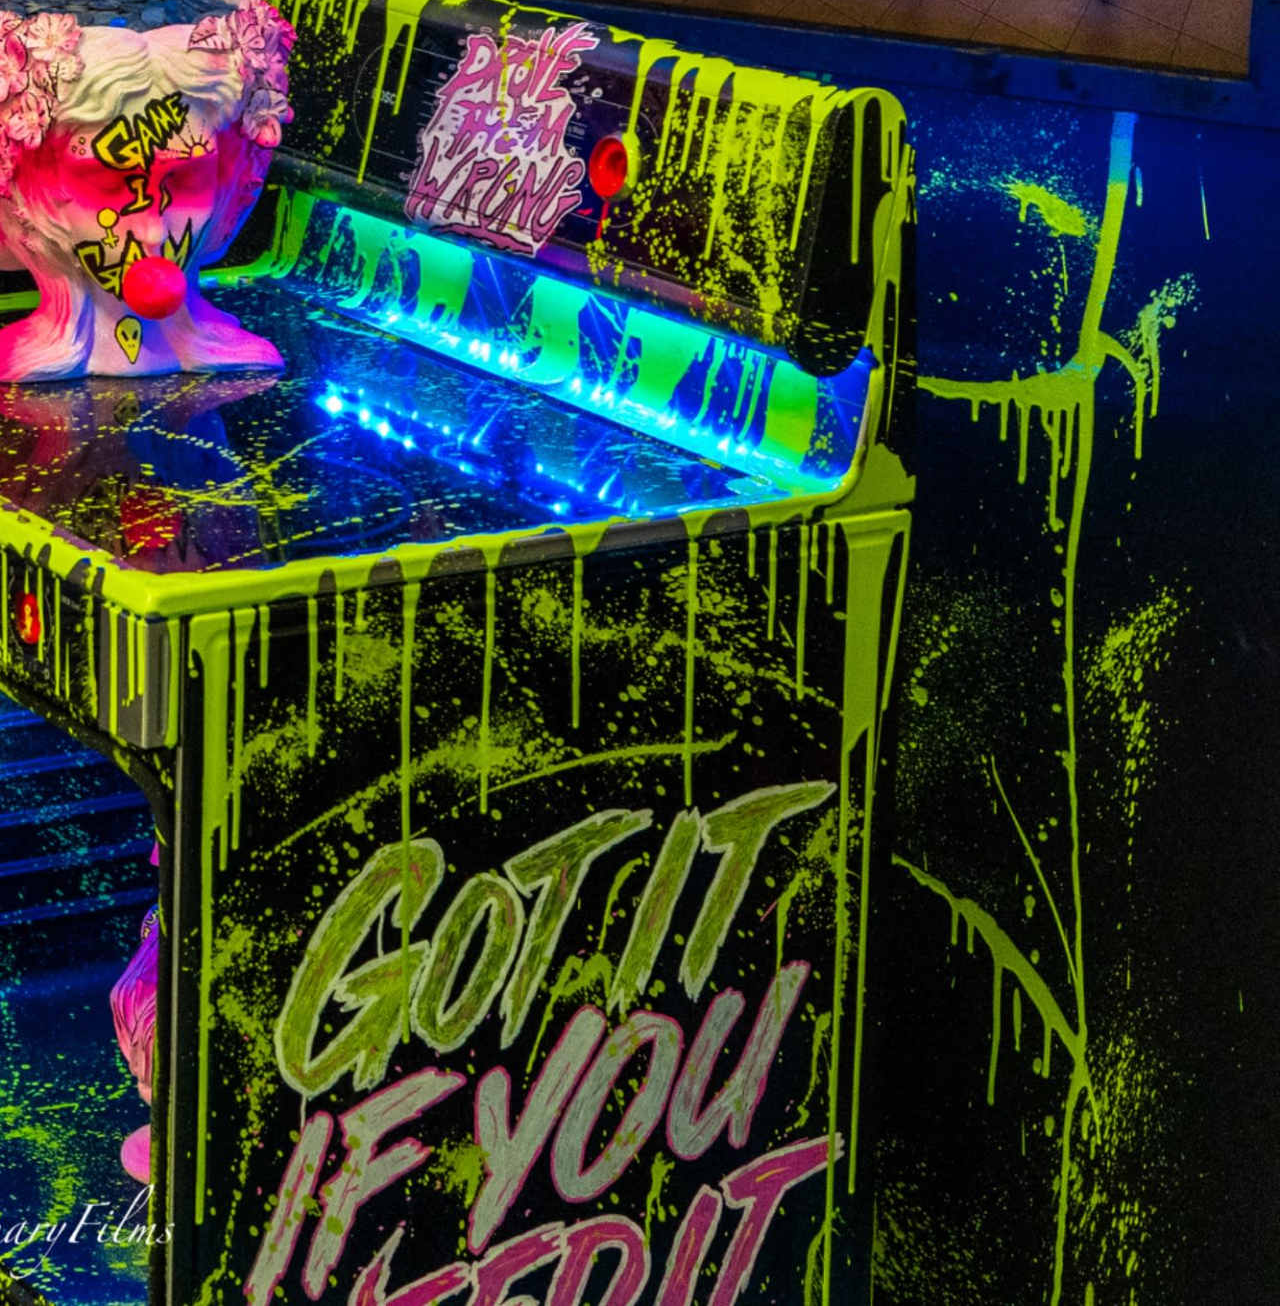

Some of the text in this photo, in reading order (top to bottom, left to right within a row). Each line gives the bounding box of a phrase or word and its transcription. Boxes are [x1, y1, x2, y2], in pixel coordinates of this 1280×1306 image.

[436, 21, 601, 106] PROVE
[91, 90, 190, 175] GAME
[406, 136, 587, 243] WRONG
[273, 779, 839, 1098] GOT IT
[242, 959, 812, 1306] IF YOU
